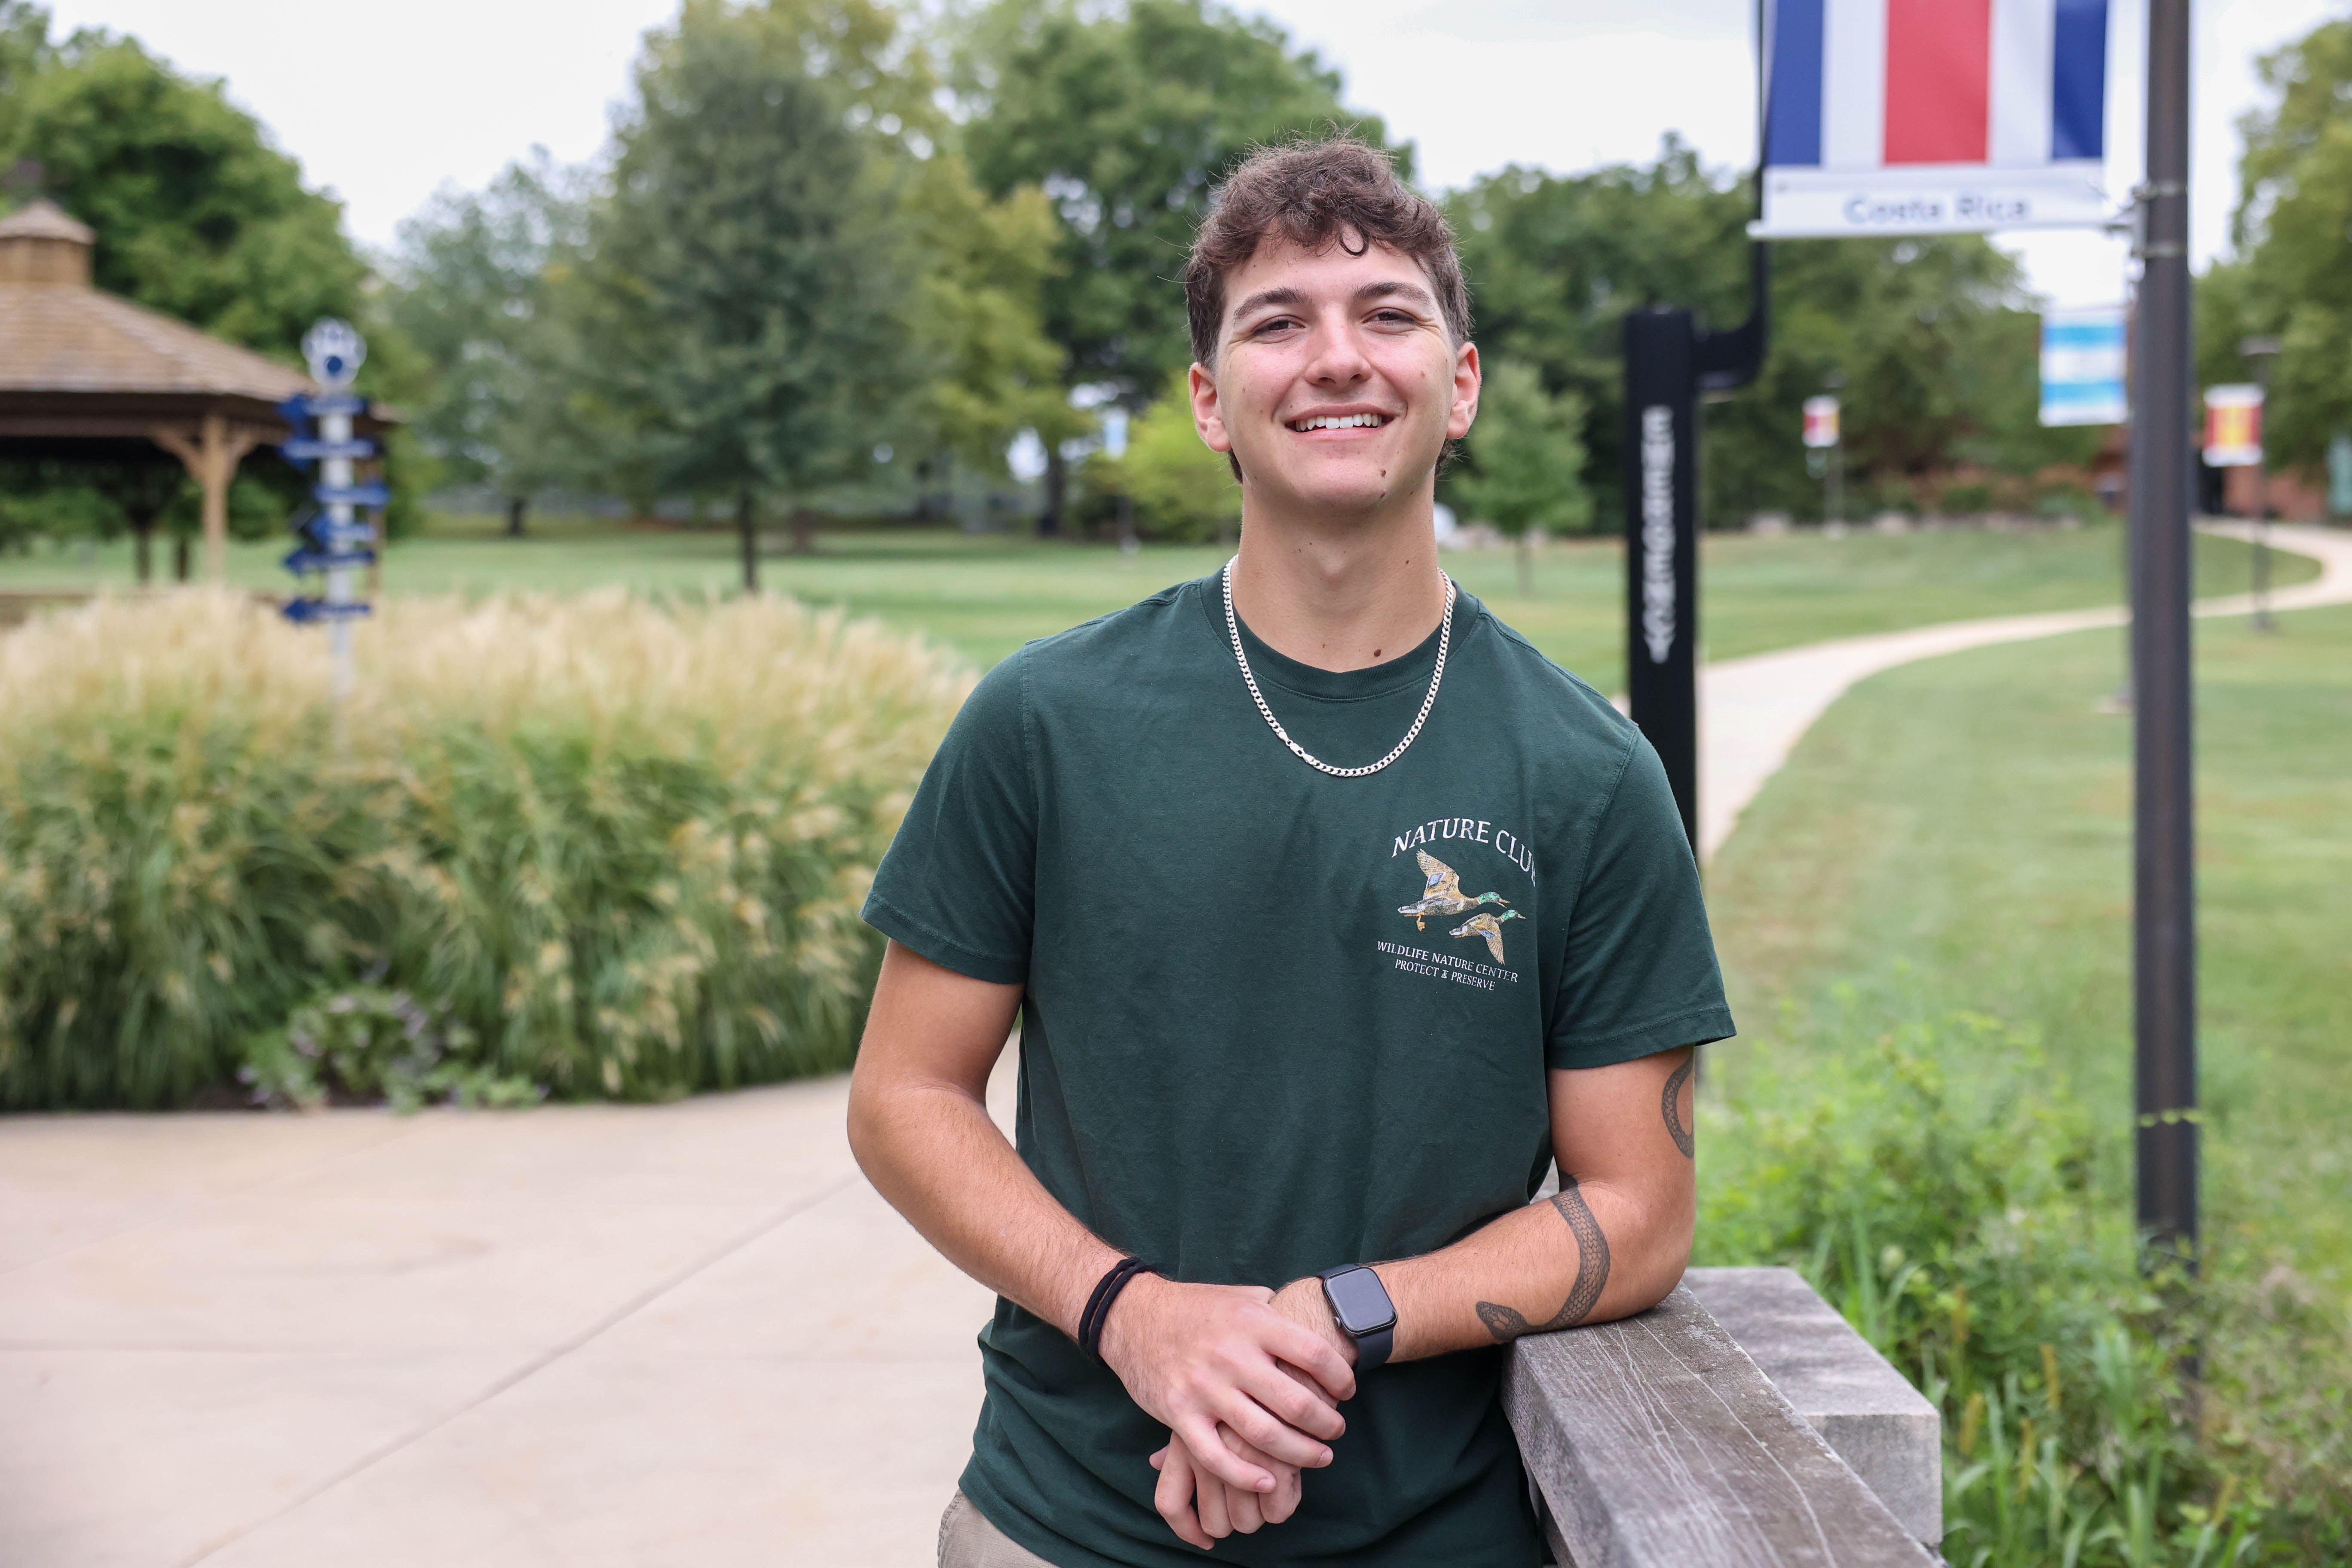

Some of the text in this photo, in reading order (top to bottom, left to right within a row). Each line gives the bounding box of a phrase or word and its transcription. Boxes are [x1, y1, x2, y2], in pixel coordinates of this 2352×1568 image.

[1844, 193, 2030, 224] Costa Rica
[1391, 818, 1491, 858] NATURE
[1377, 940, 1518, 983] WILDLIFE NATURE CENTER
[1395, 959, 1496, 991] PROTECT & PRESERVE
